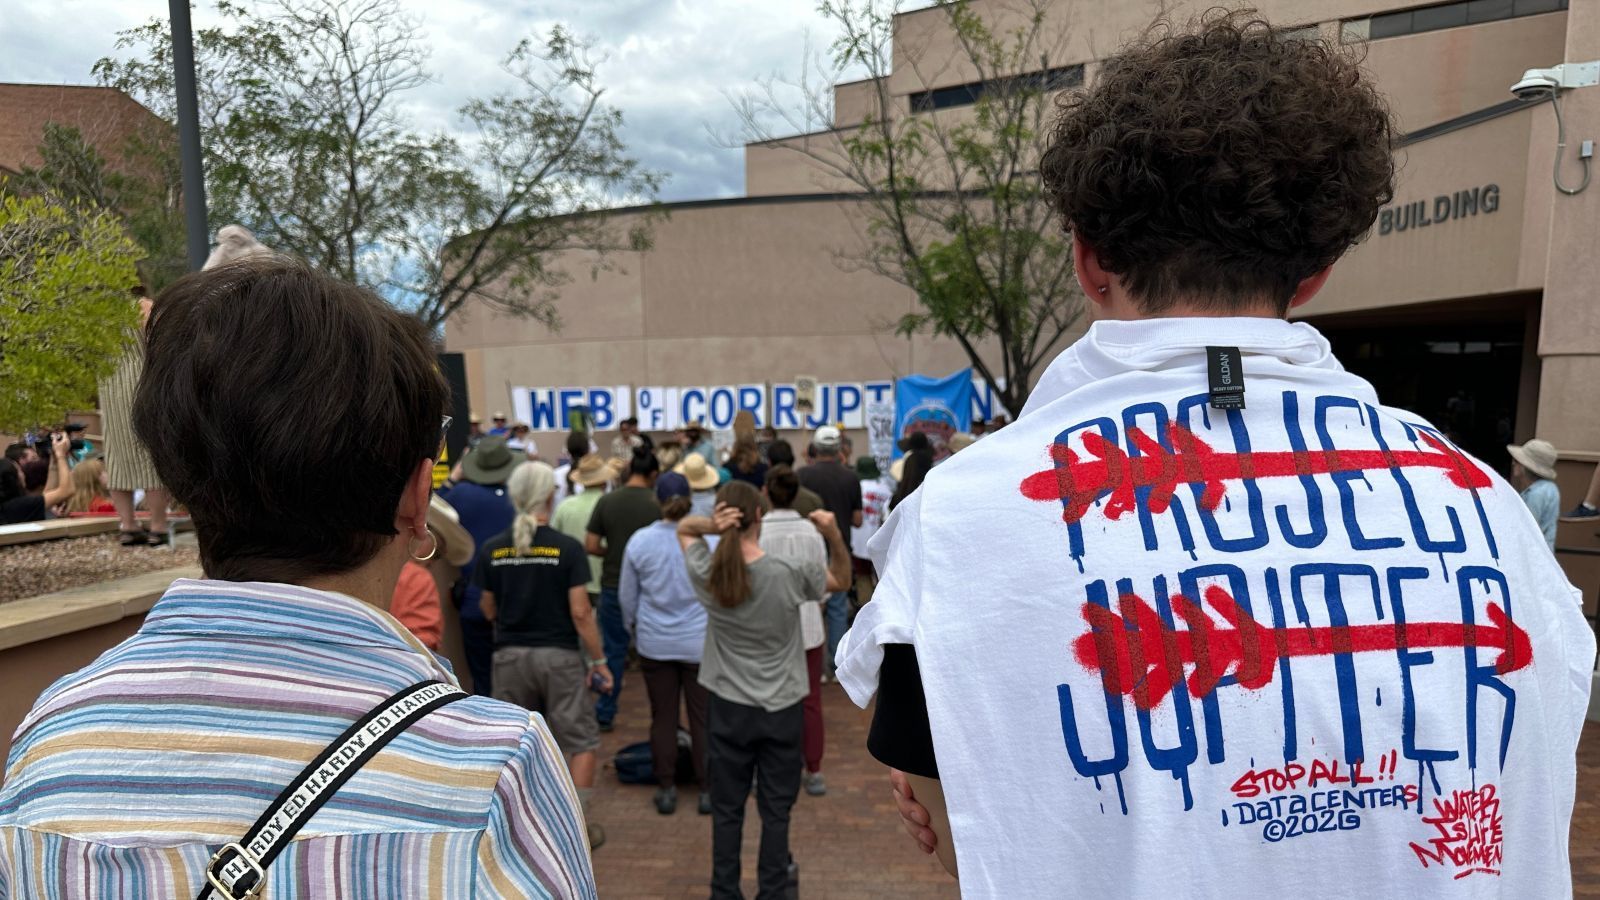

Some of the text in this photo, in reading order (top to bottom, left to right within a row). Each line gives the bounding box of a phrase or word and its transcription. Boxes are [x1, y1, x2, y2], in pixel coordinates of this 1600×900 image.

[1378, 184, 1500, 236] BUILDING
[1220, 353, 1231, 385] GILDAN
[682, 382, 993, 429] CORRUPTN
[1053, 390, 1500, 560] PROJECT
[1056, 563, 1516, 778] JUPITER
[225, 816, 283, 880] HRDY
[283, 794, 306, 820] ED
[304, 734, 366, 795] HARDY
[366, 714, 391, 738] ED
[390, 685, 443, 718] HARDY
[1231, 763, 1306, 797] STOP
[1433, 784, 1500, 821] WATER
